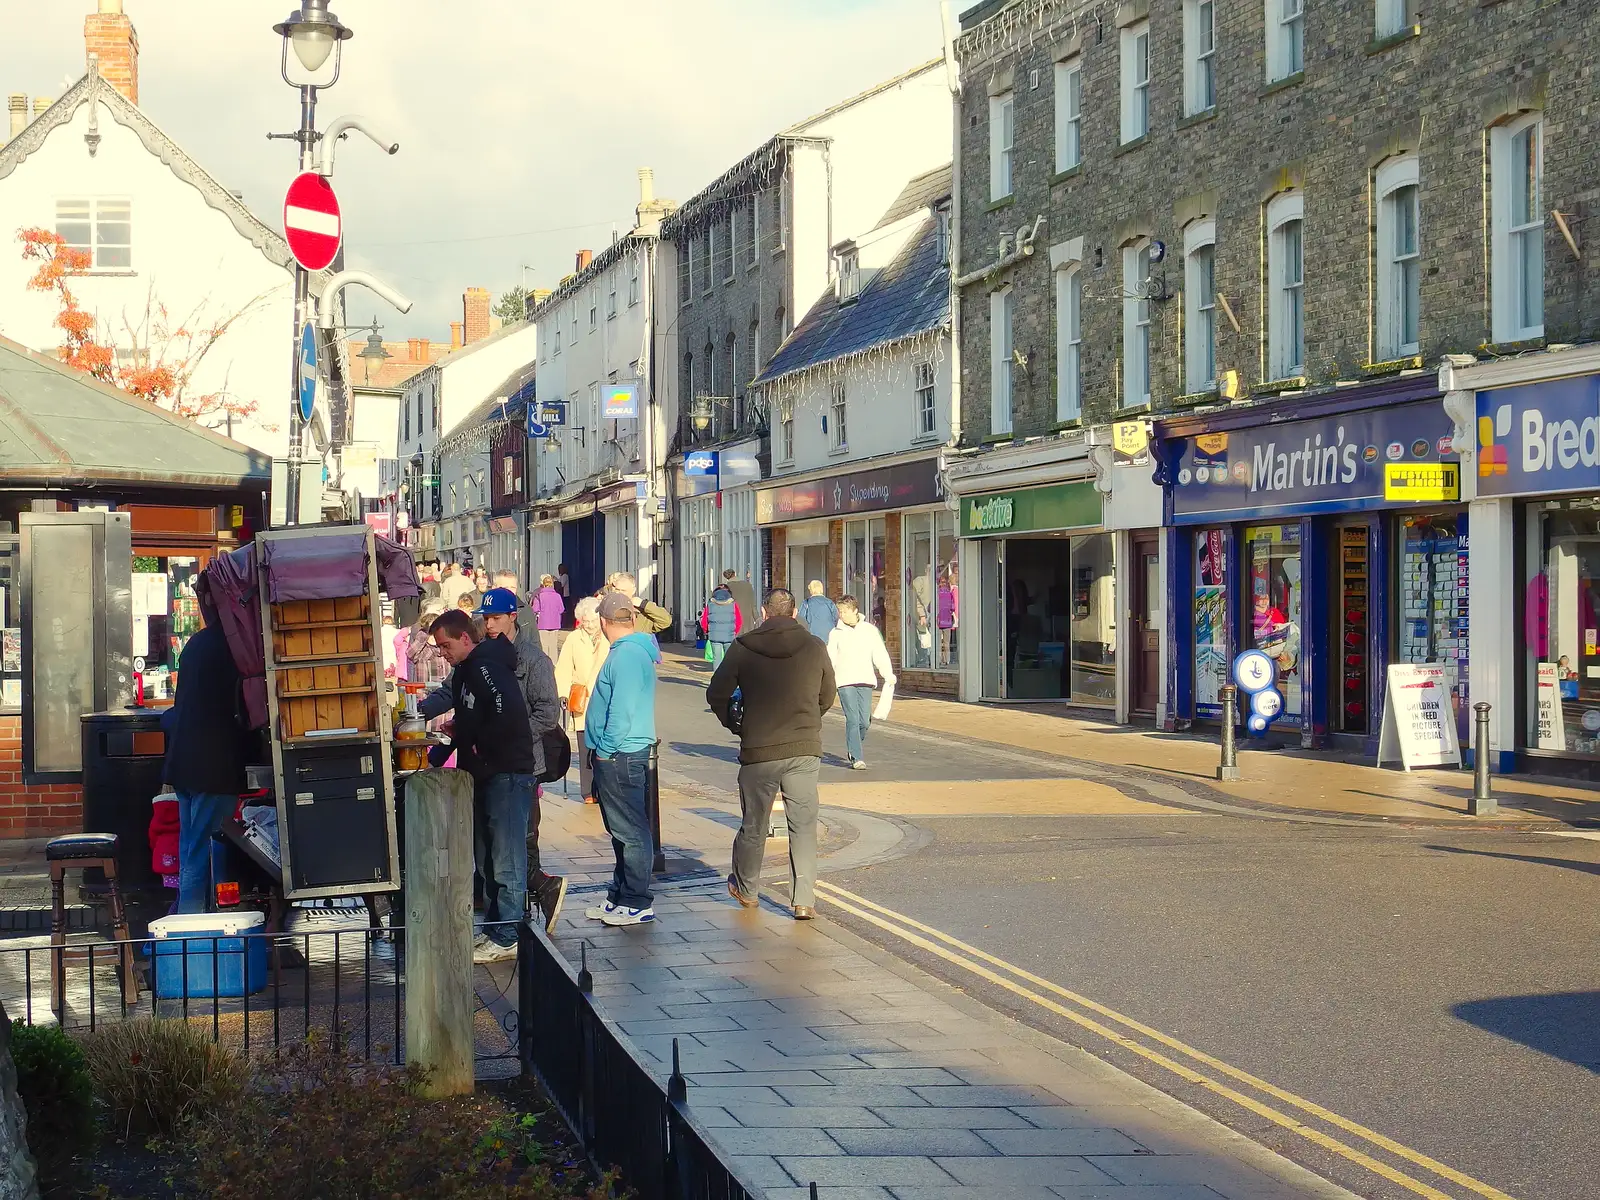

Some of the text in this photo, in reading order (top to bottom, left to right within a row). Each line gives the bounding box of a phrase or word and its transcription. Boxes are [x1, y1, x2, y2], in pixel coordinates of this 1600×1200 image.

[606, 407, 633, 415] CORAL
[542, 413, 560, 422] HILL
[688, 457, 714, 470] pdsa
[1250, 426, 1358, 492] Martin's
[1390, 471, 1444, 479] WESTERN
[1406, 478, 1444, 487] UNION
[849, 482, 889, 503] Superdrug
[480, 666, 494, 687] HELLY
[1412, 668, 1443, 677] Express
[1406, 701, 1440, 711] CHILDREN
[1411, 711, 1438, 720] IN NEED
[1411, 721, 1441, 730] PICTURE
[1414, 731, 1443, 741] SPECIAL
